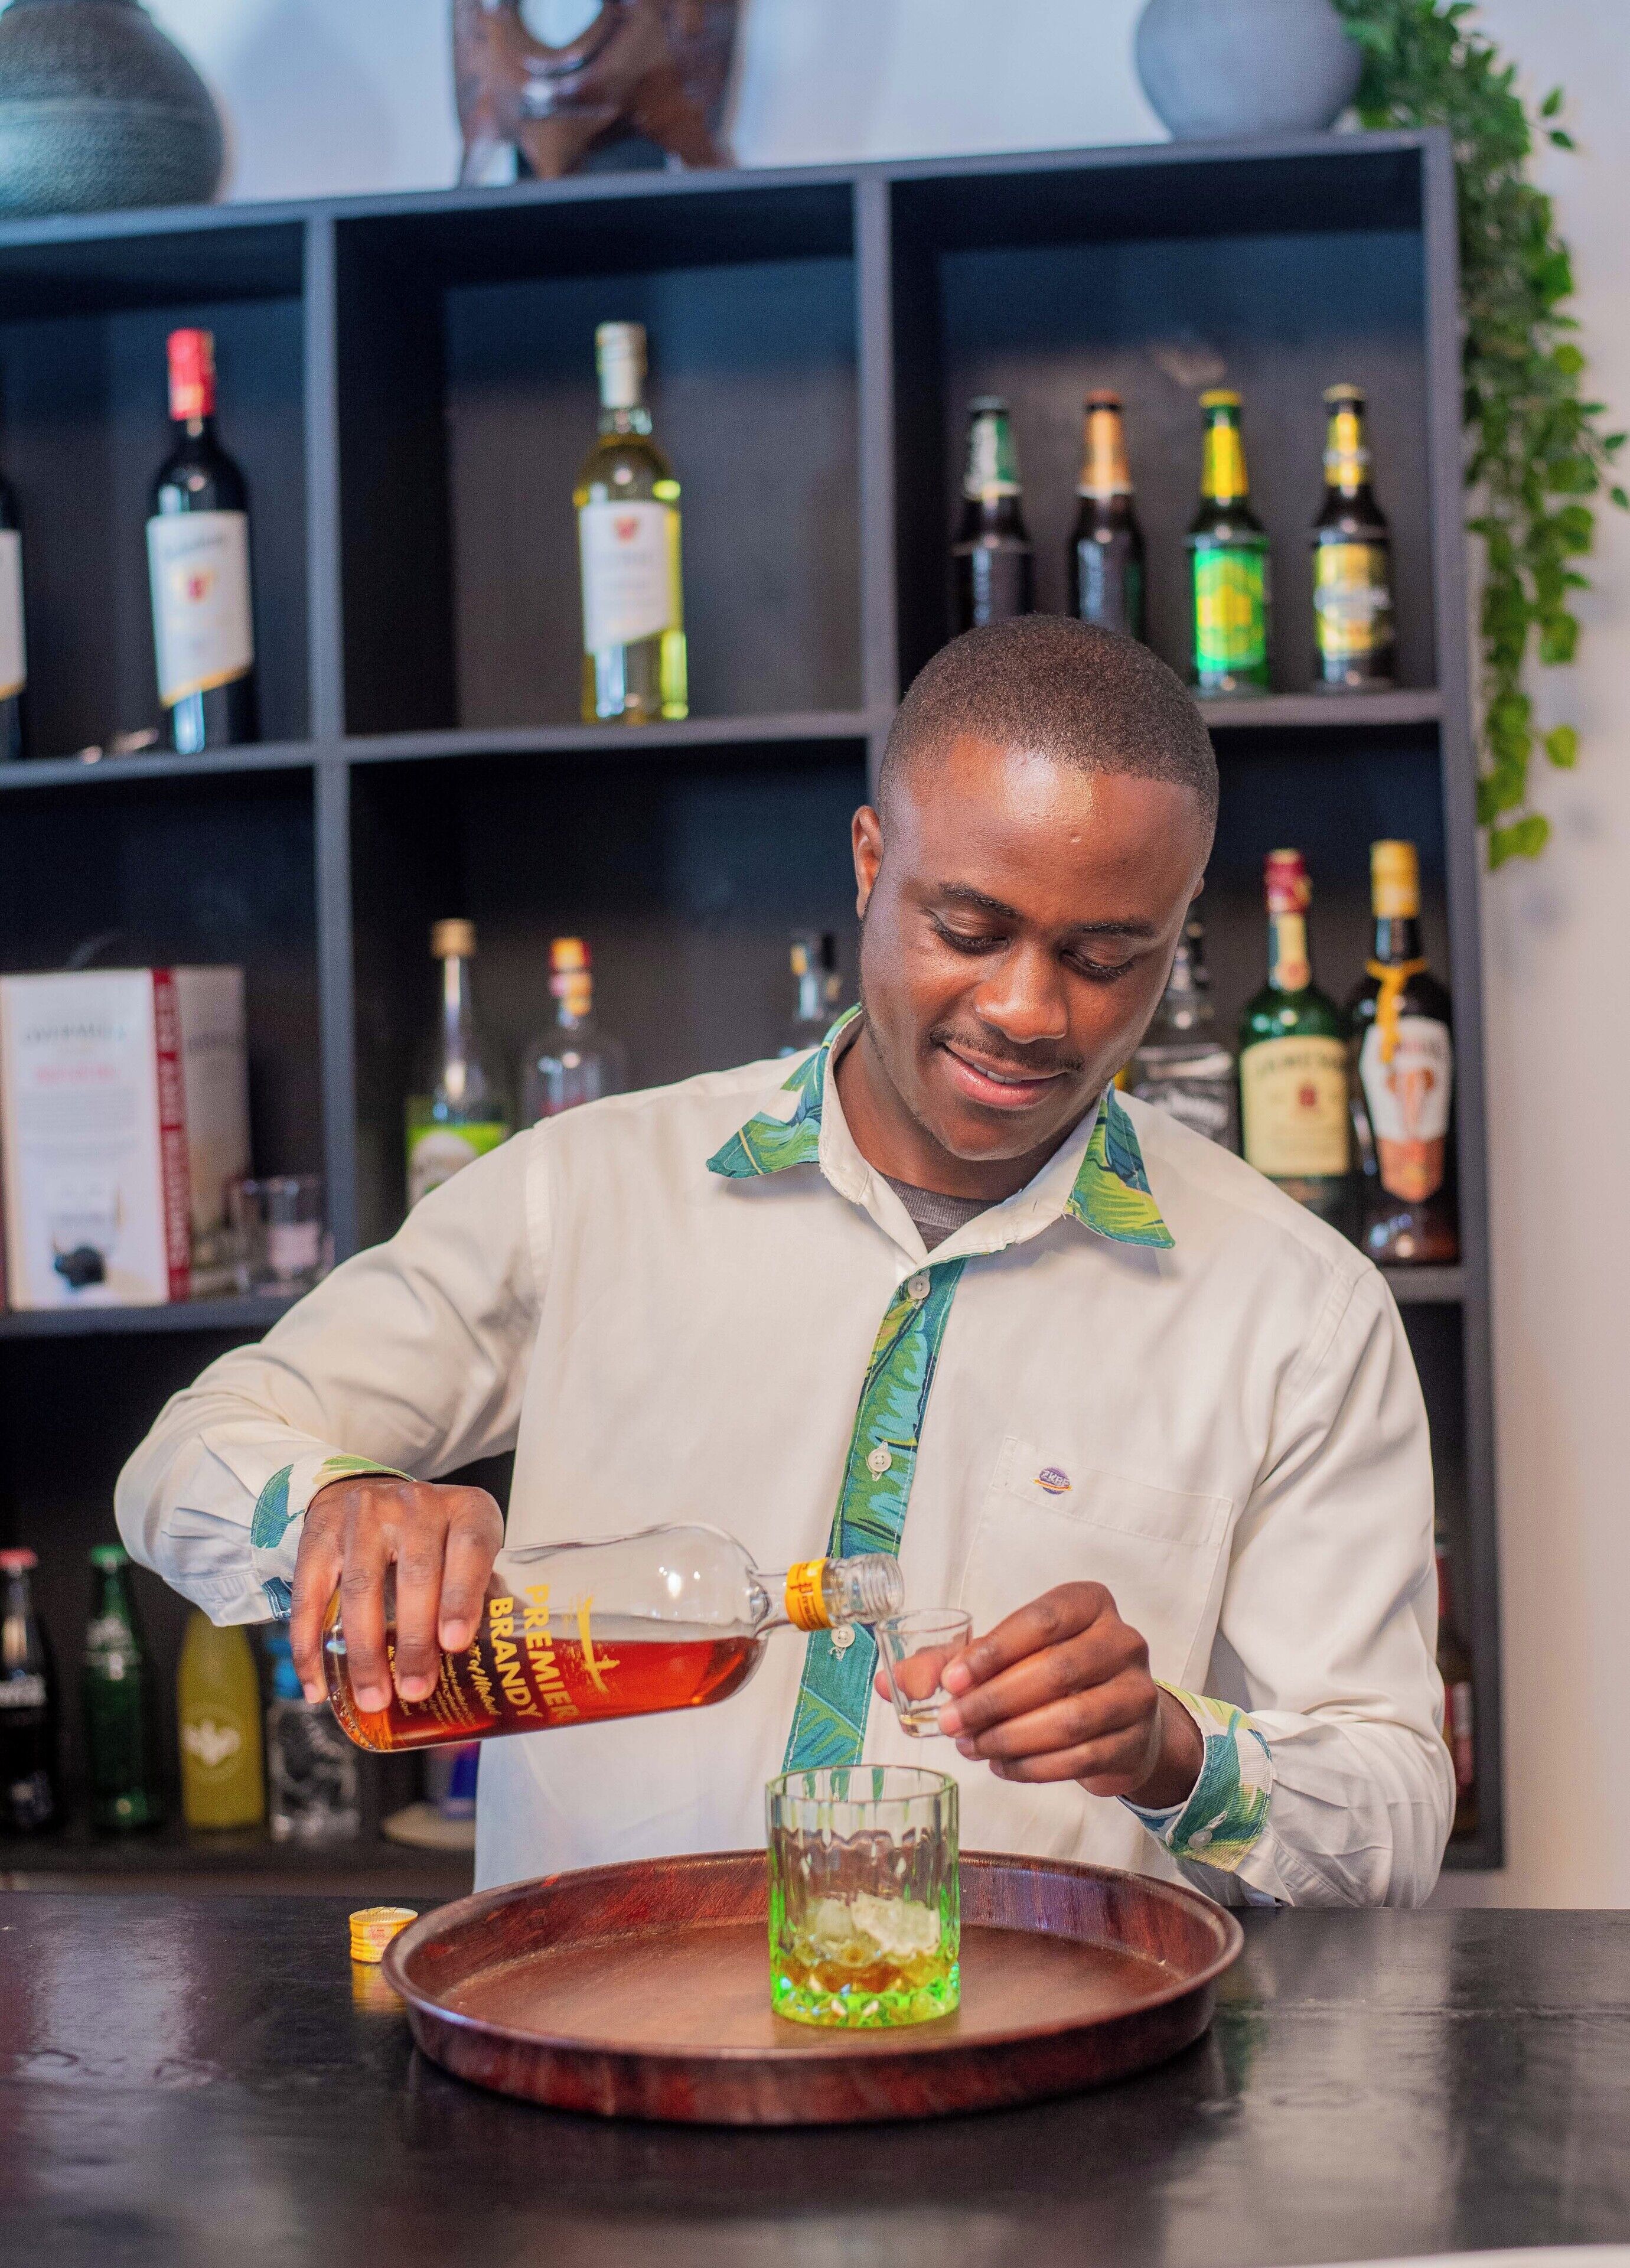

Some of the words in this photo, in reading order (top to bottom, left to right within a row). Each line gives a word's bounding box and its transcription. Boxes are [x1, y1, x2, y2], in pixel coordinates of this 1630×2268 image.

[467, 1660, 485, 1674] of
[488, 1596, 543, 1718] BRANDY
[524, 1583, 580, 1719] PREMIER
